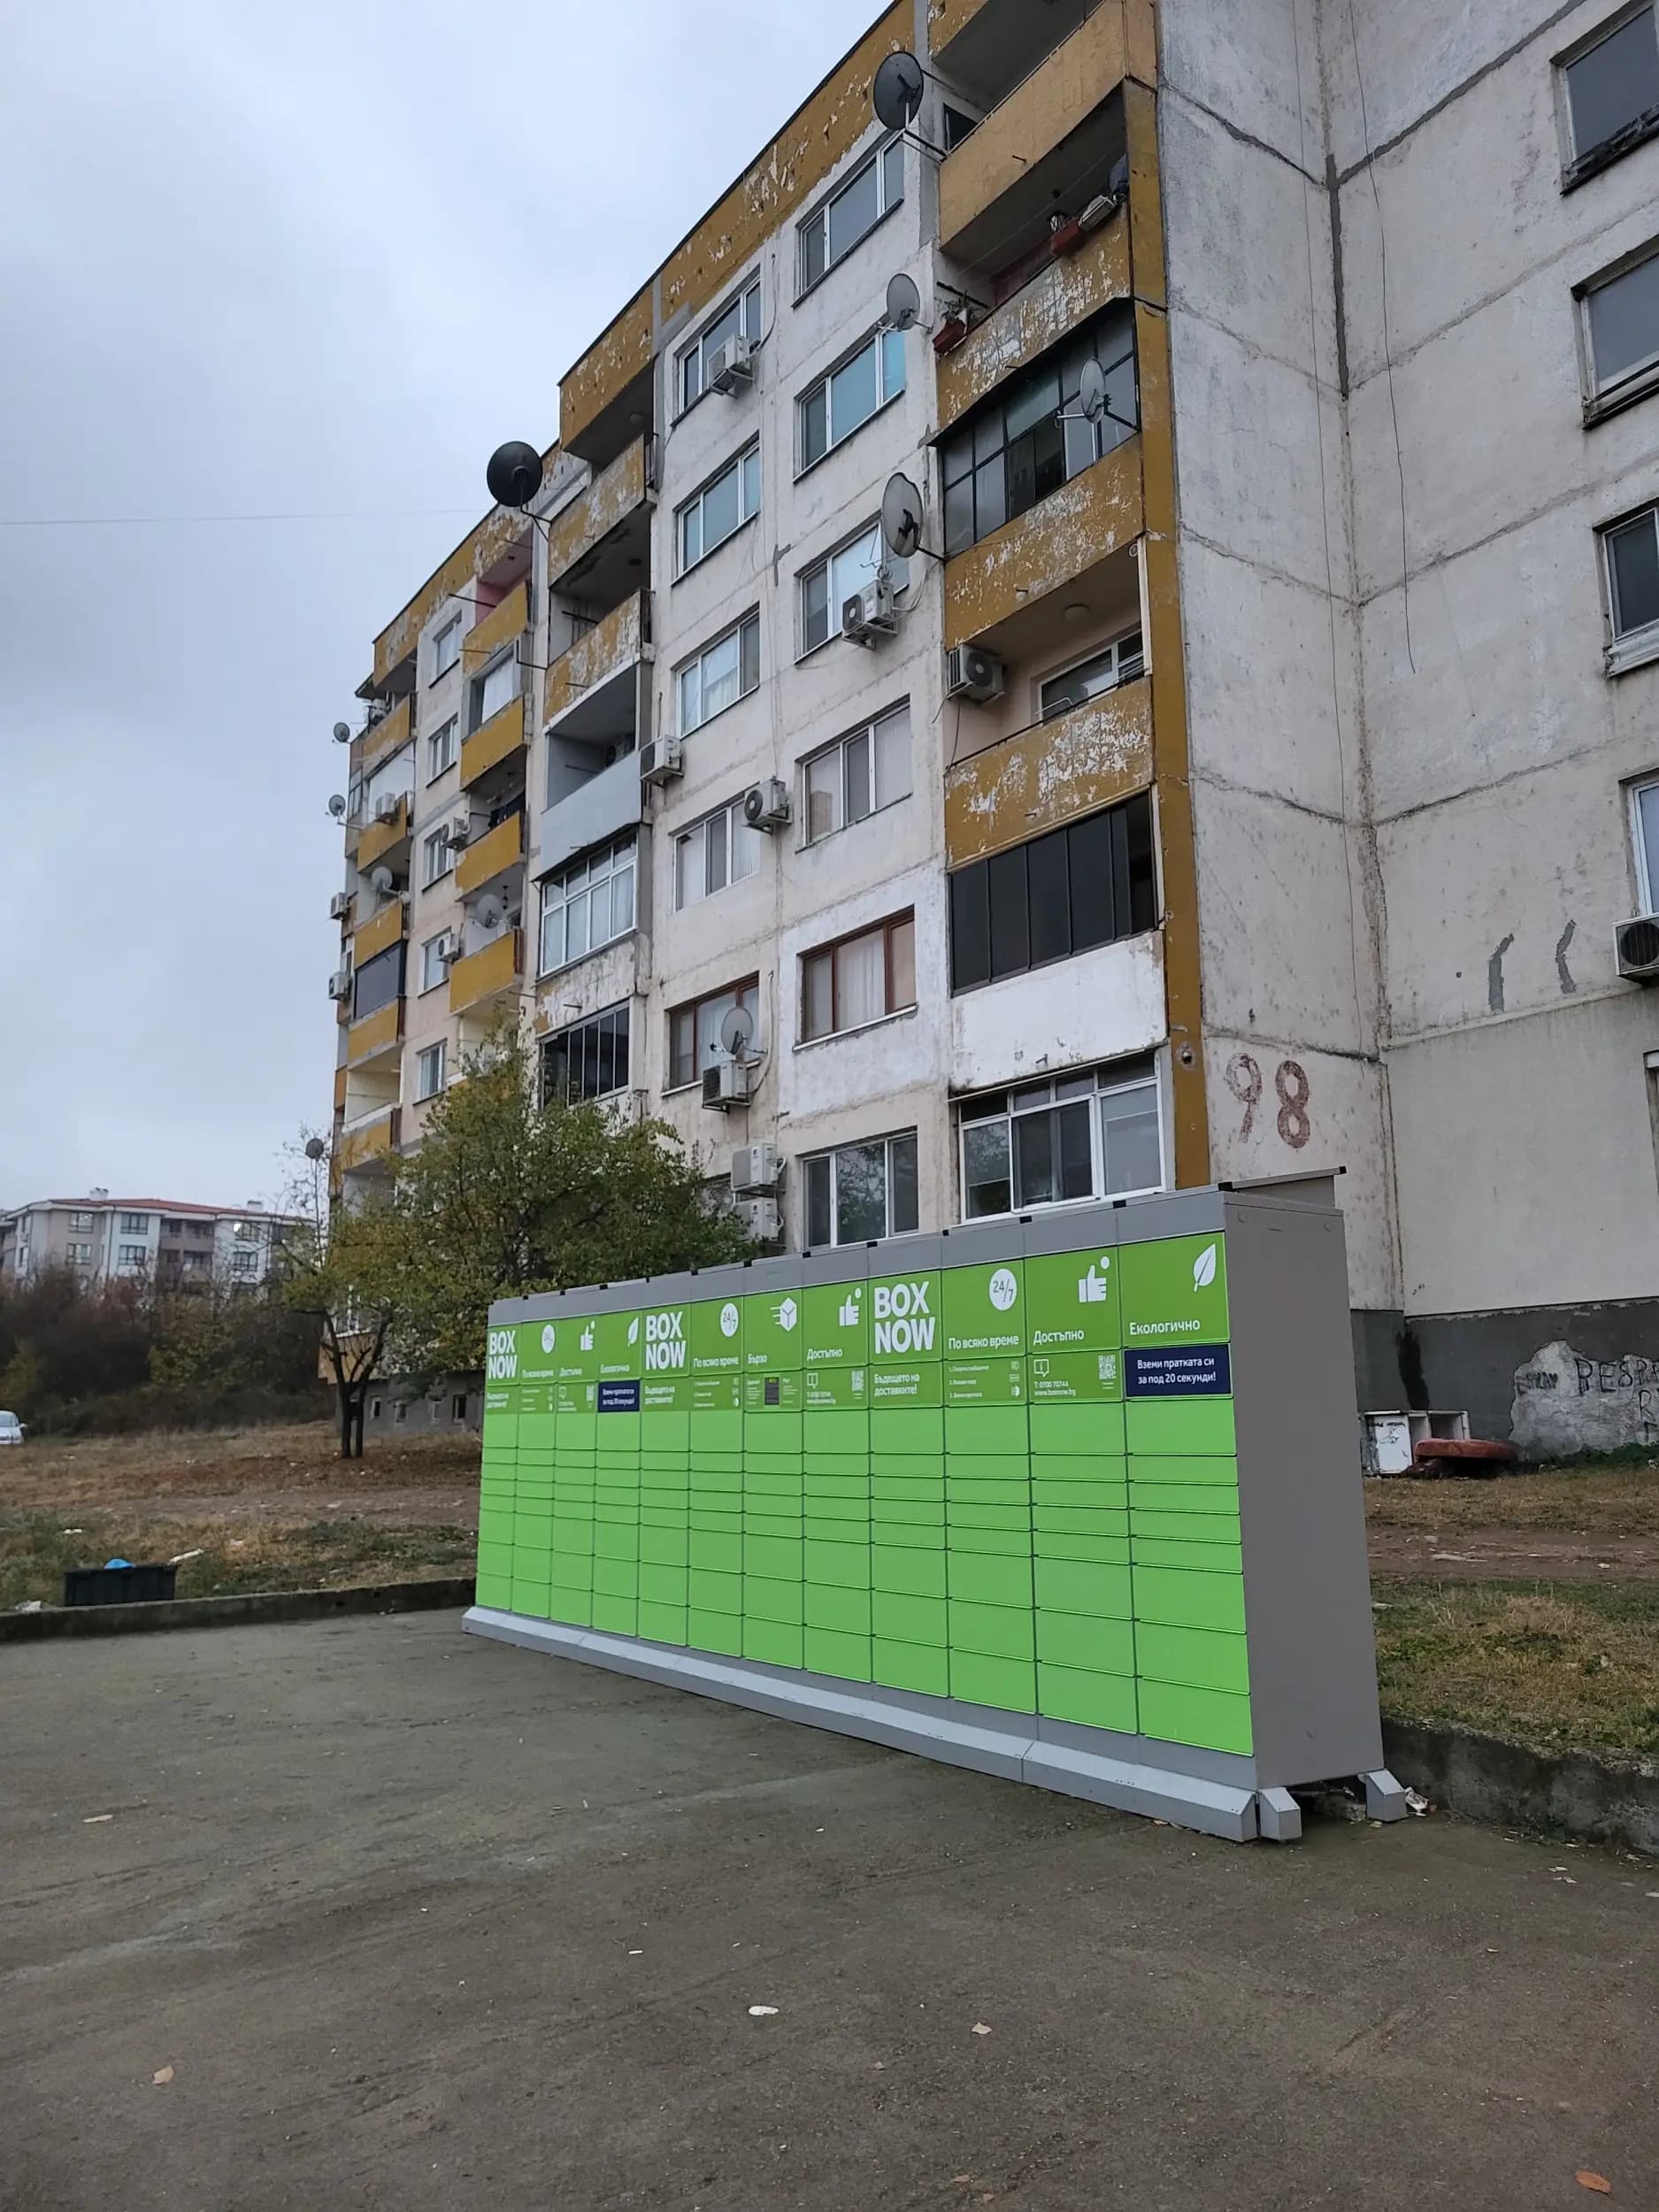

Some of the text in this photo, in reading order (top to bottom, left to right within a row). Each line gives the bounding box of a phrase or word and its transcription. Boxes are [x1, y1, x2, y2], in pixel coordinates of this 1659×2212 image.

[1224, 1052, 1310, 1148] 98
[874, 1281, 930, 1319] BOX
[993, 1279, 1014, 1302] 24/7
[645, 1311, 683, 1341] BOX
[874, 1317, 935, 1354] NOW
[1033, 1330, 1085, 1346] Достъпно
[1129, 1319, 1201, 1335] Екологично
[489, 1330, 516, 1355] BOX
[949, 1335, 1019, 1349] По всяко време
[488, 1355, 518, 1379] NOW
[645, 1340, 687, 1371] NOW
[1137, 1359, 1163, 1369] Вземи
[1164, 1358, 1202, 1370] пратката
[1148, 1376, 1164, 1385] под
[1164, 1373, 1176, 1383] 20
[1177, 1371, 1217, 1385] секунди!
